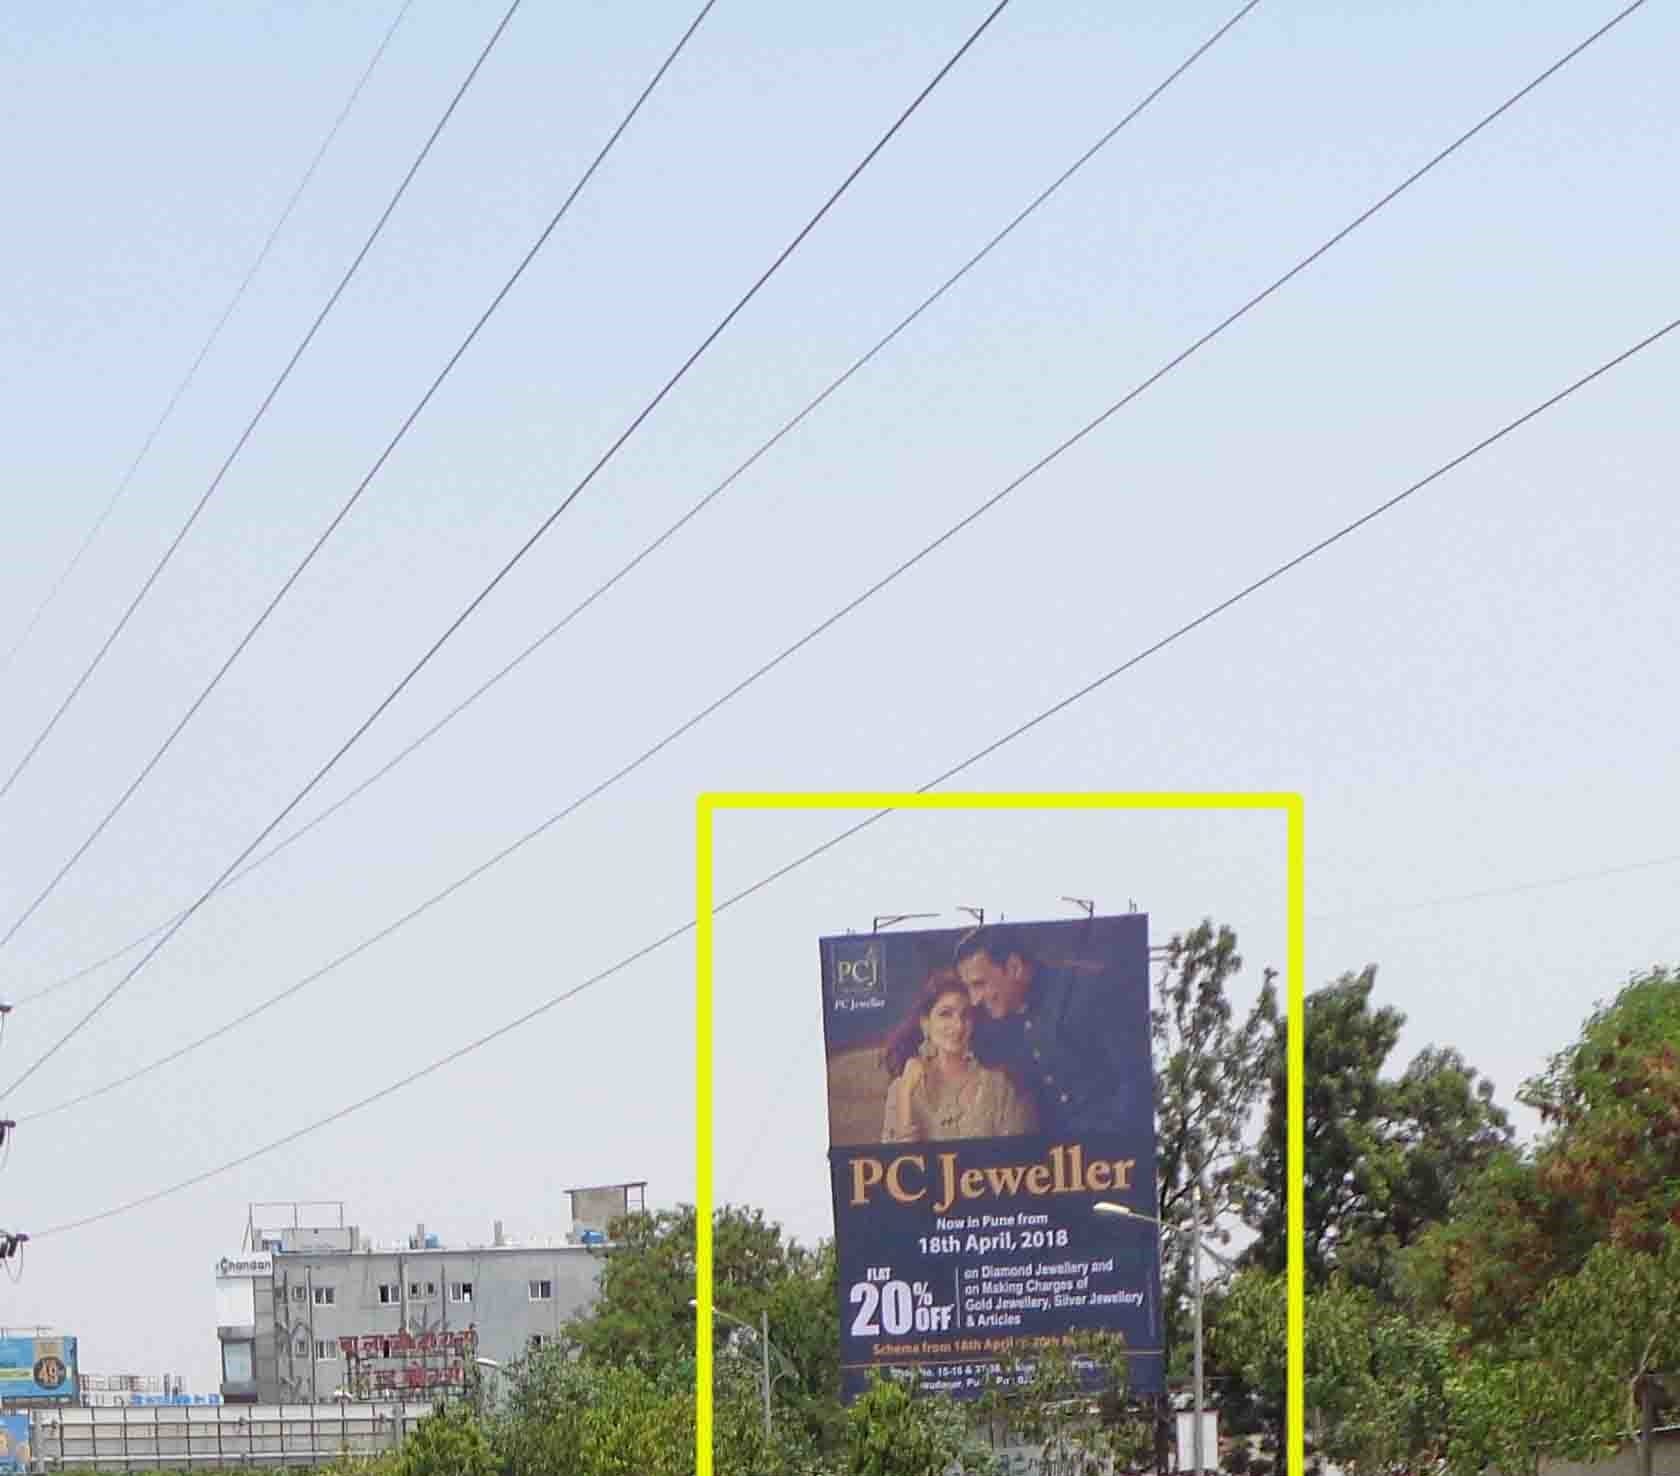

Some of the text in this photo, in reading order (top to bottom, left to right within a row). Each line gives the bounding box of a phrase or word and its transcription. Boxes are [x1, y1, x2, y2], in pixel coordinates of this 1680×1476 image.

[848, 1144, 1136, 1213] PC Jeweller
[936, 1211, 1049, 1232] Now in Pune from
[919, 1228, 1070, 1256] 18th April, 2018
[867, 1267, 892, 1282] FLAT
[964, 1257, 1114, 1281] on Diamond Jewellery and
[964, 1276, 1089, 1297] on Making Charges of
[965, 1298, 993, 1313] Gold
[1054, 1293, 1087, 1309] Silver
[1089, 1289, 1144, 1307] Jewellery
[967, 1312, 1022, 1329] & Articles
